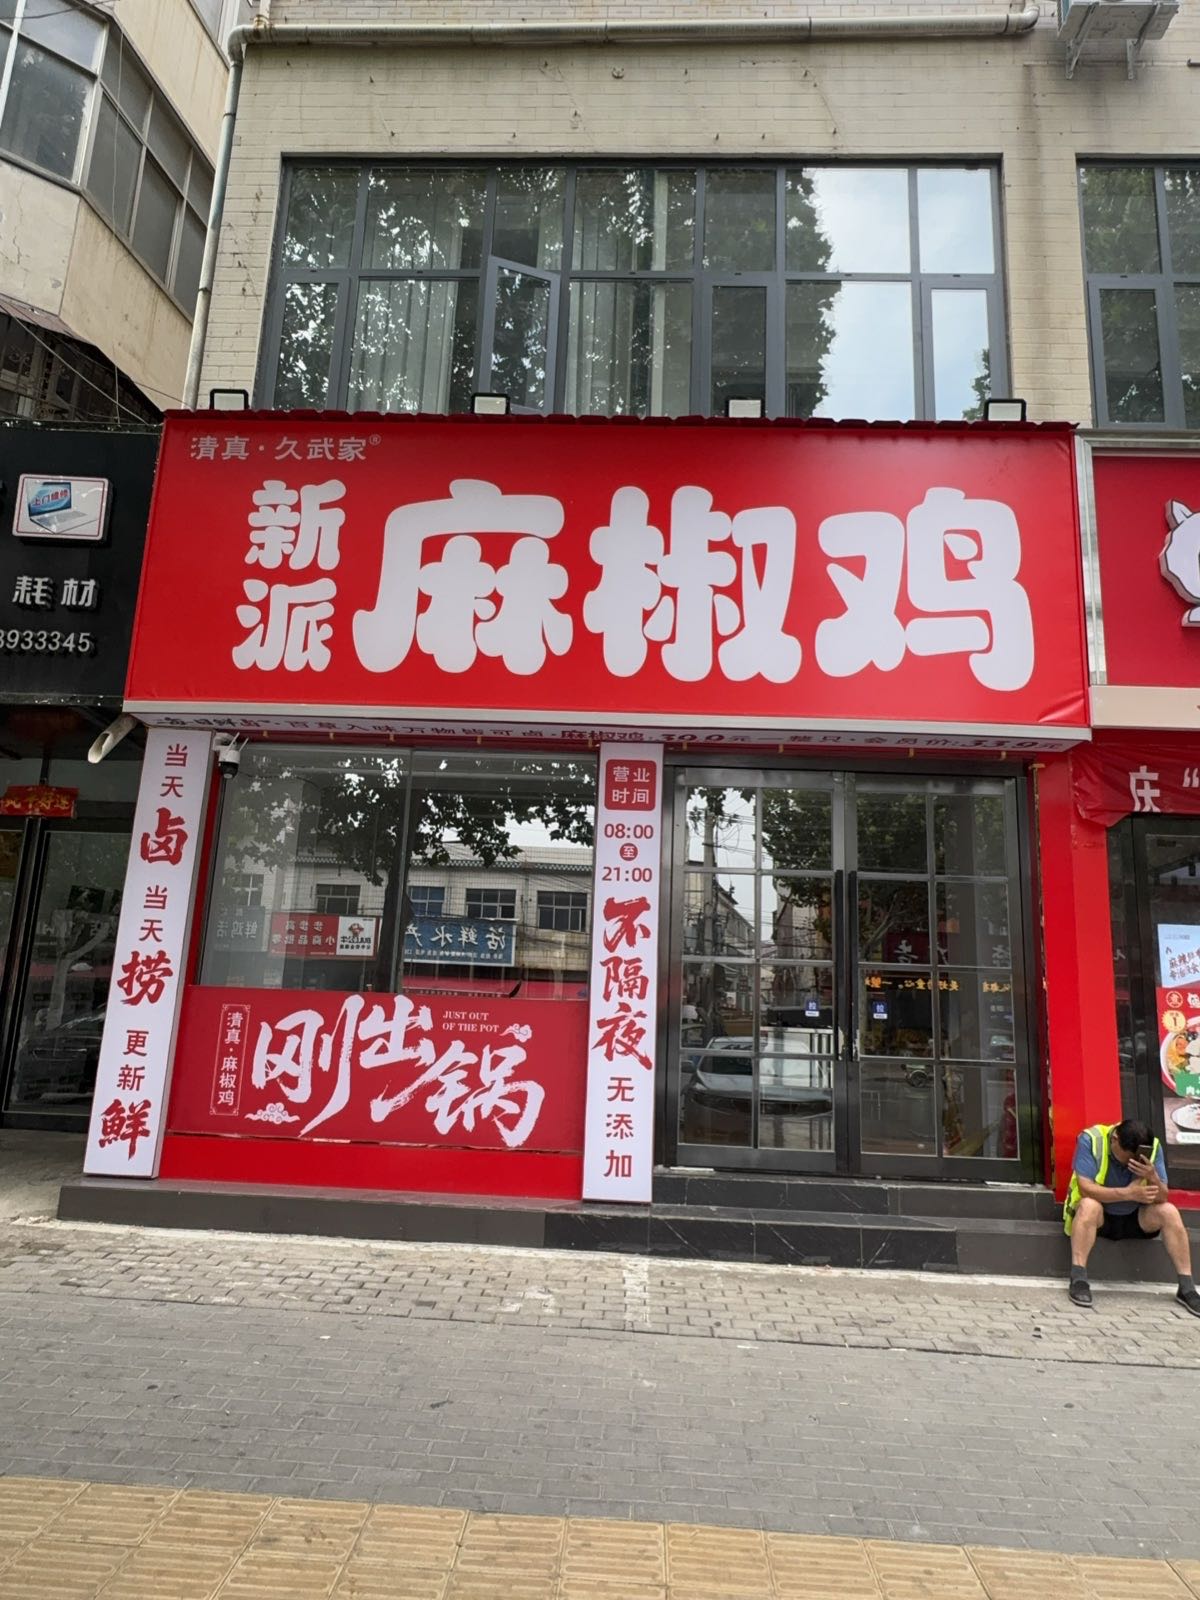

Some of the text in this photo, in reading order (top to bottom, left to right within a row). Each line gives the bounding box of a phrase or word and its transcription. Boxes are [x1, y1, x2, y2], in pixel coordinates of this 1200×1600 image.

[232, 479, 347, 672] 新派
[12, 576, 97, 607] 耗材
[352, 479, 1035, 692] 麻椒鸡
[613, 766, 650, 783] 营业
[611, 787, 650, 804] 时间
[604, 823, 654, 839] 08:00
[623, 845, 635, 858] 至
[602, 866, 653, 883] 21:00
[443, 1010, 489, 1021] JUST OUT
[442, 1022, 499, 1033] OF THE POT
[251, 994, 546, 1148] 刚出锅
